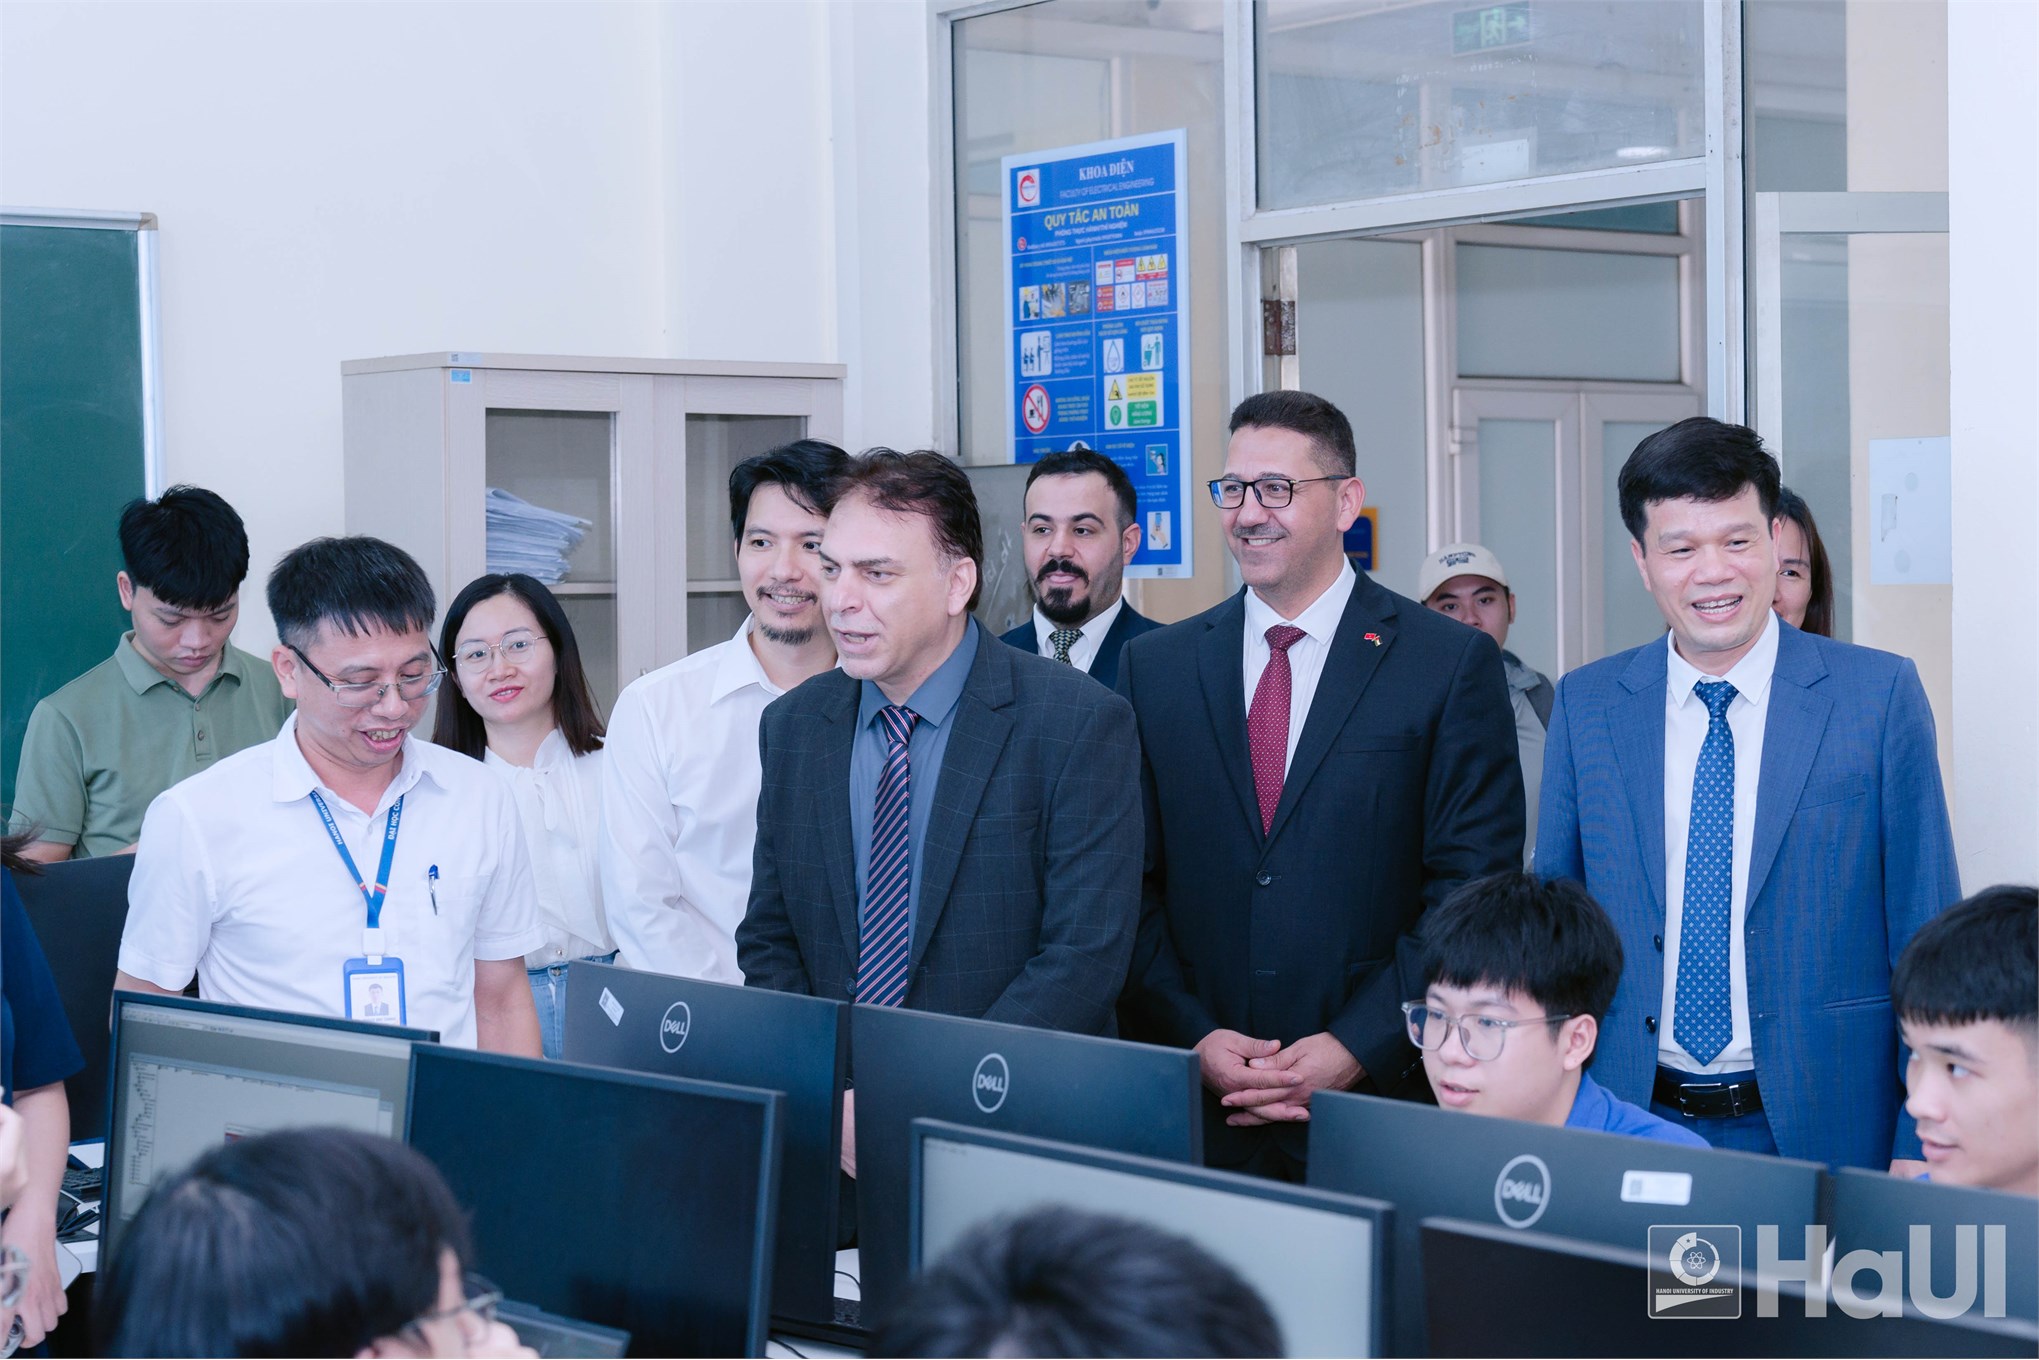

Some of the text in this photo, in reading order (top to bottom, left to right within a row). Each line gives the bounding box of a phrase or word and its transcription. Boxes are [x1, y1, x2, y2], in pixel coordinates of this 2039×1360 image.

[1078, 158, 1135, 181] KHOA ĐIỆN
[1044, 212, 1066, 231] QUY
[1092, 207, 1107, 222] AN
[1109, 201, 1139, 218] TOÀN
[390, 812, 399, 826] HỌC
[328, 822, 343, 845] HANOI
[1501, 1178, 1544, 1205] DELL
